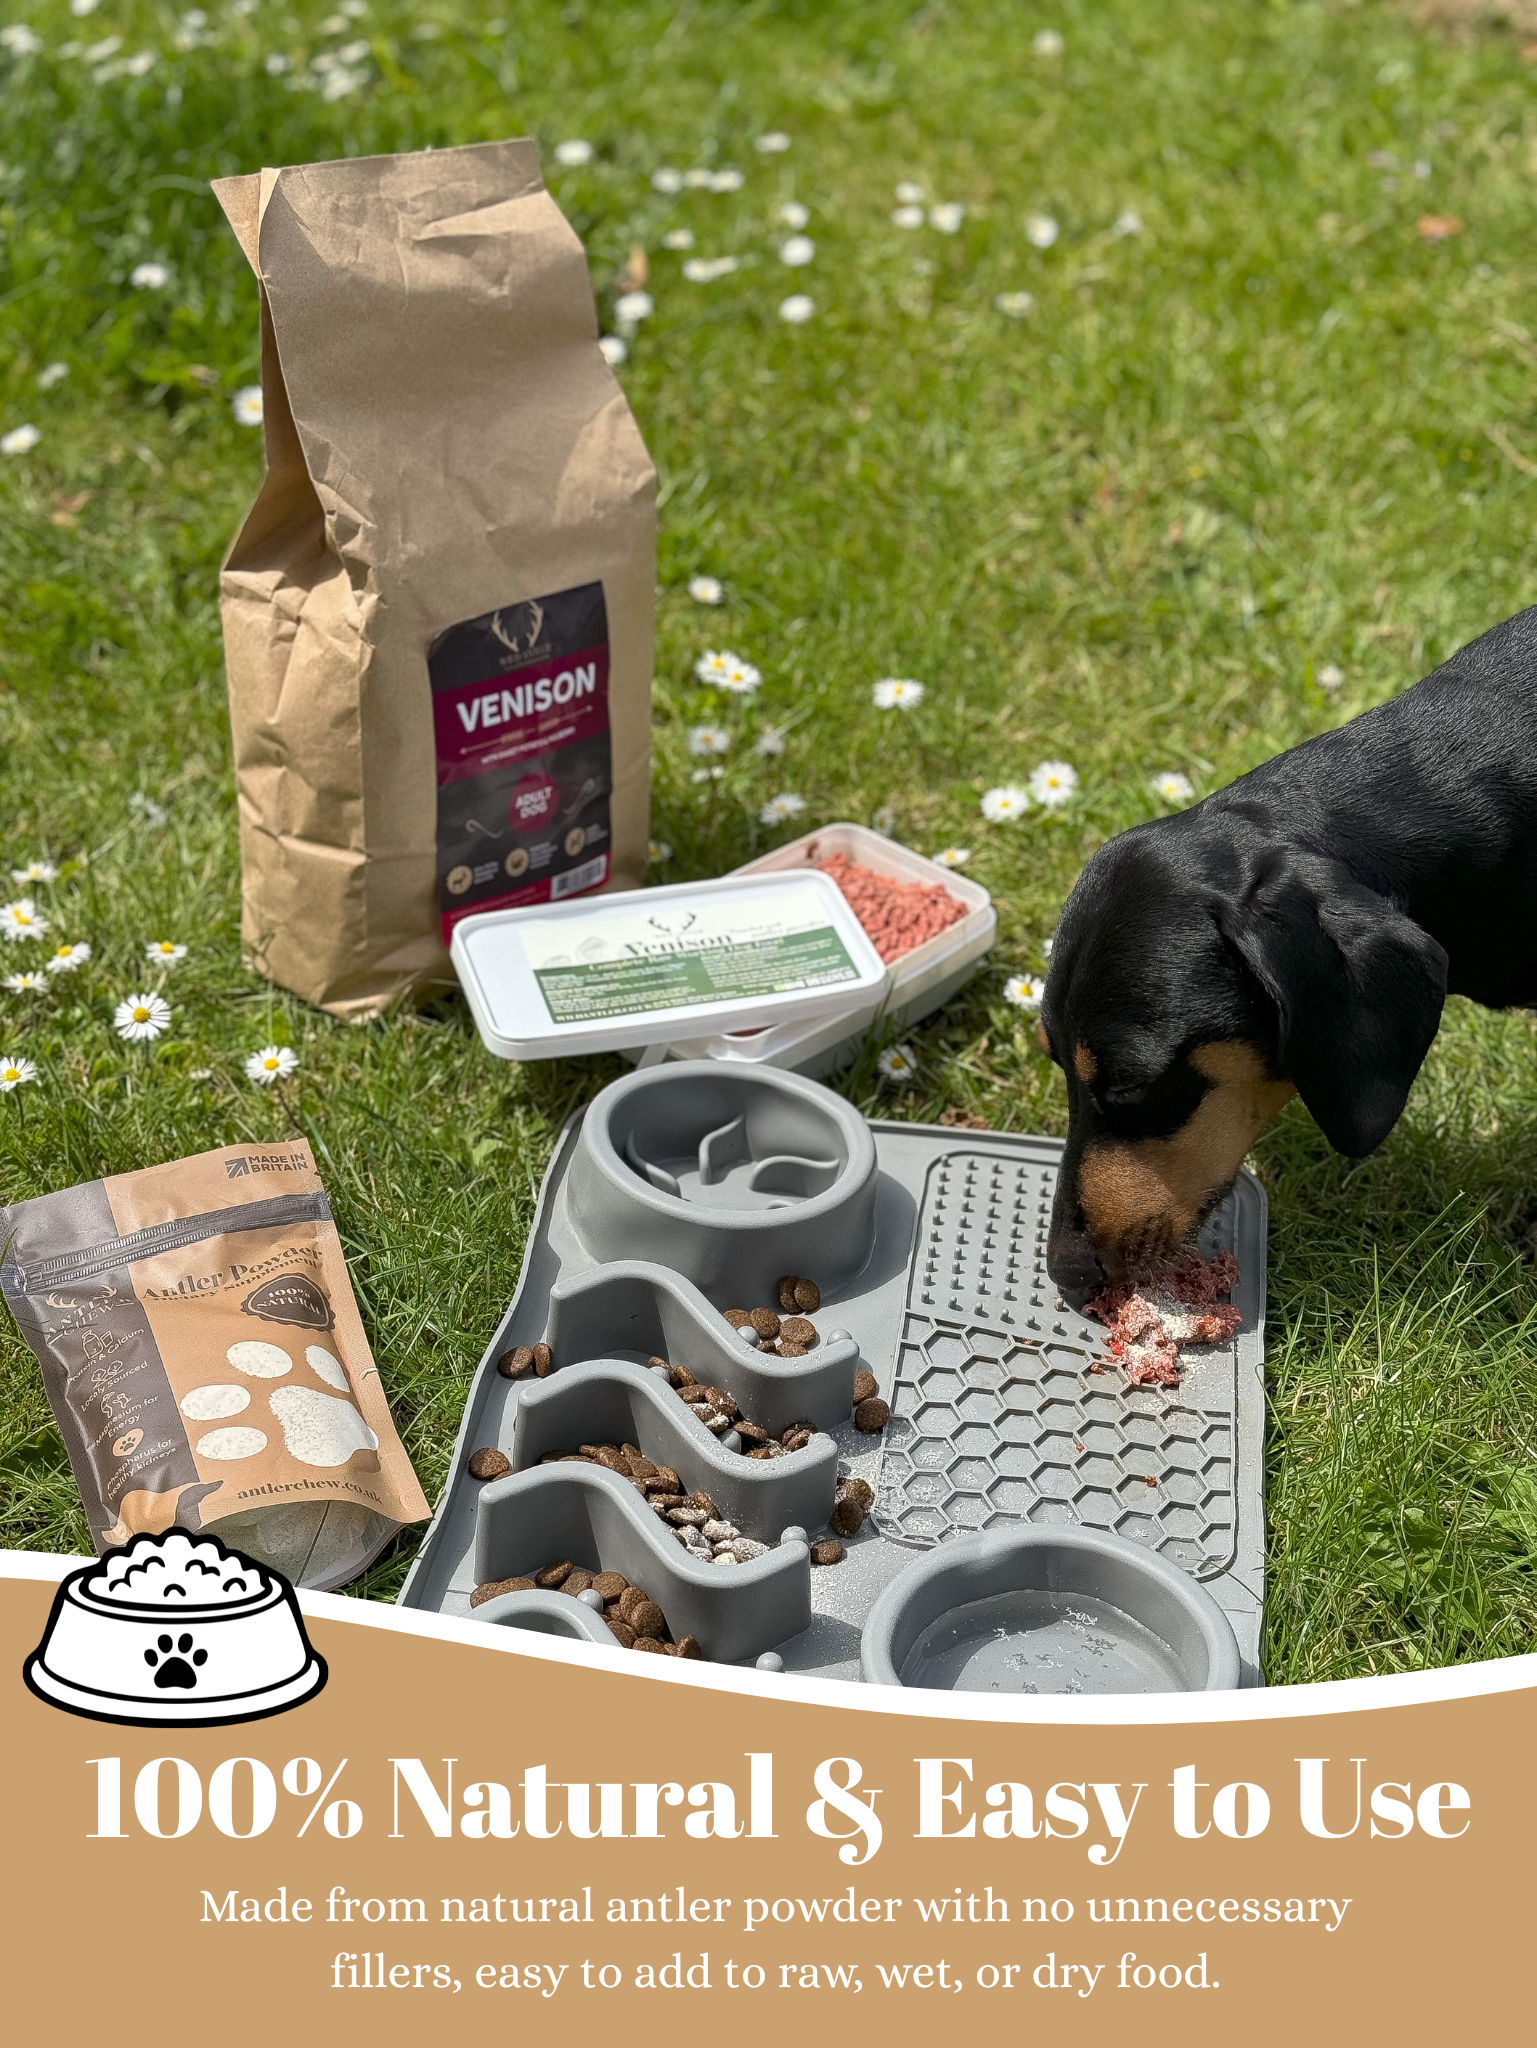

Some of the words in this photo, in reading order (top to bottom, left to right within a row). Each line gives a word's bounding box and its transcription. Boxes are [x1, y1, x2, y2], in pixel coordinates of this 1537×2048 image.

[456, 662, 596, 733] VENISON
[515, 785, 553, 809] ADULT
[519, 802, 548, 819] DOG
[625, 932, 733, 957] Venison
[248, 1155, 288, 1165] MADE
[290, 1153, 306, 1162] IN
[250, 1161, 309, 1173] BRITAIN
[142, 1272, 223, 1300] Antler
[229, 1246, 323, 1282] Powder
[267, 1286, 312, 1299] 100%
[256, 1295, 326, 1317] NATURAL
[107, 1328, 145, 1354] Calcium
[95, 1403, 142, 1447] Magnesium
[143, 1395, 159, 1406] for
[107, 1413, 140, 1439] Energy
[157, 1438, 173, 1450] for
[108, 1467, 135, 1501] healthy
[136, 1447, 176, 1471] kidneys
[237, 1478, 384, 1505] antlerchew.co.uk
